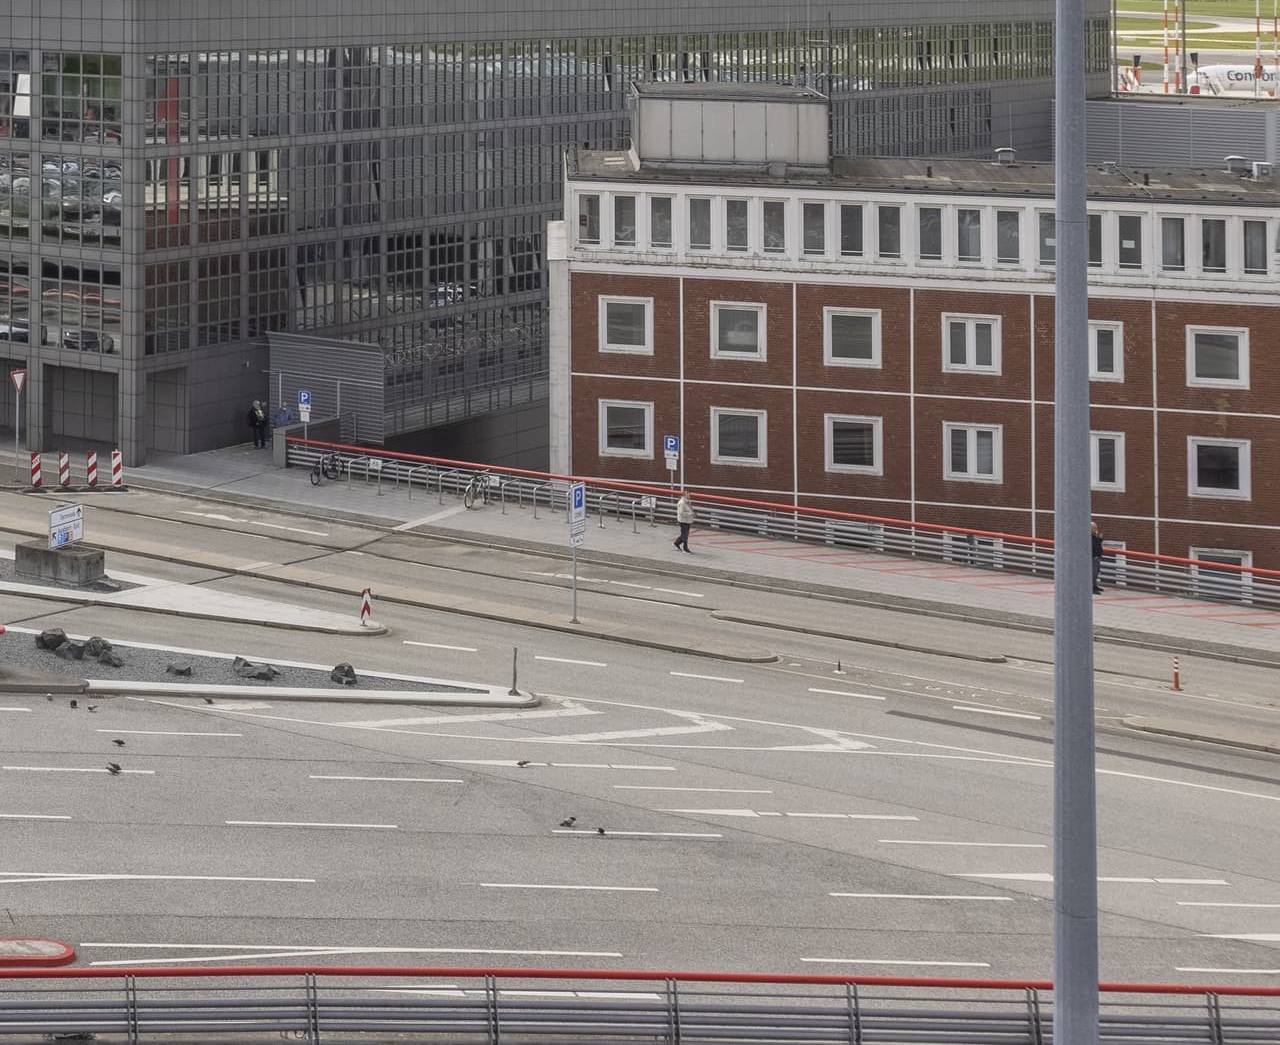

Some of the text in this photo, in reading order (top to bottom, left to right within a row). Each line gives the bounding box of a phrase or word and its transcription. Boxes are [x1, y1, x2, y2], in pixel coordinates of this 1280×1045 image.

[1227, 69, 1274, 82] Conor
[301, 392, 308, 403] P
[667, 437, 676, 449] P
[575, 490, 581, 507] P
